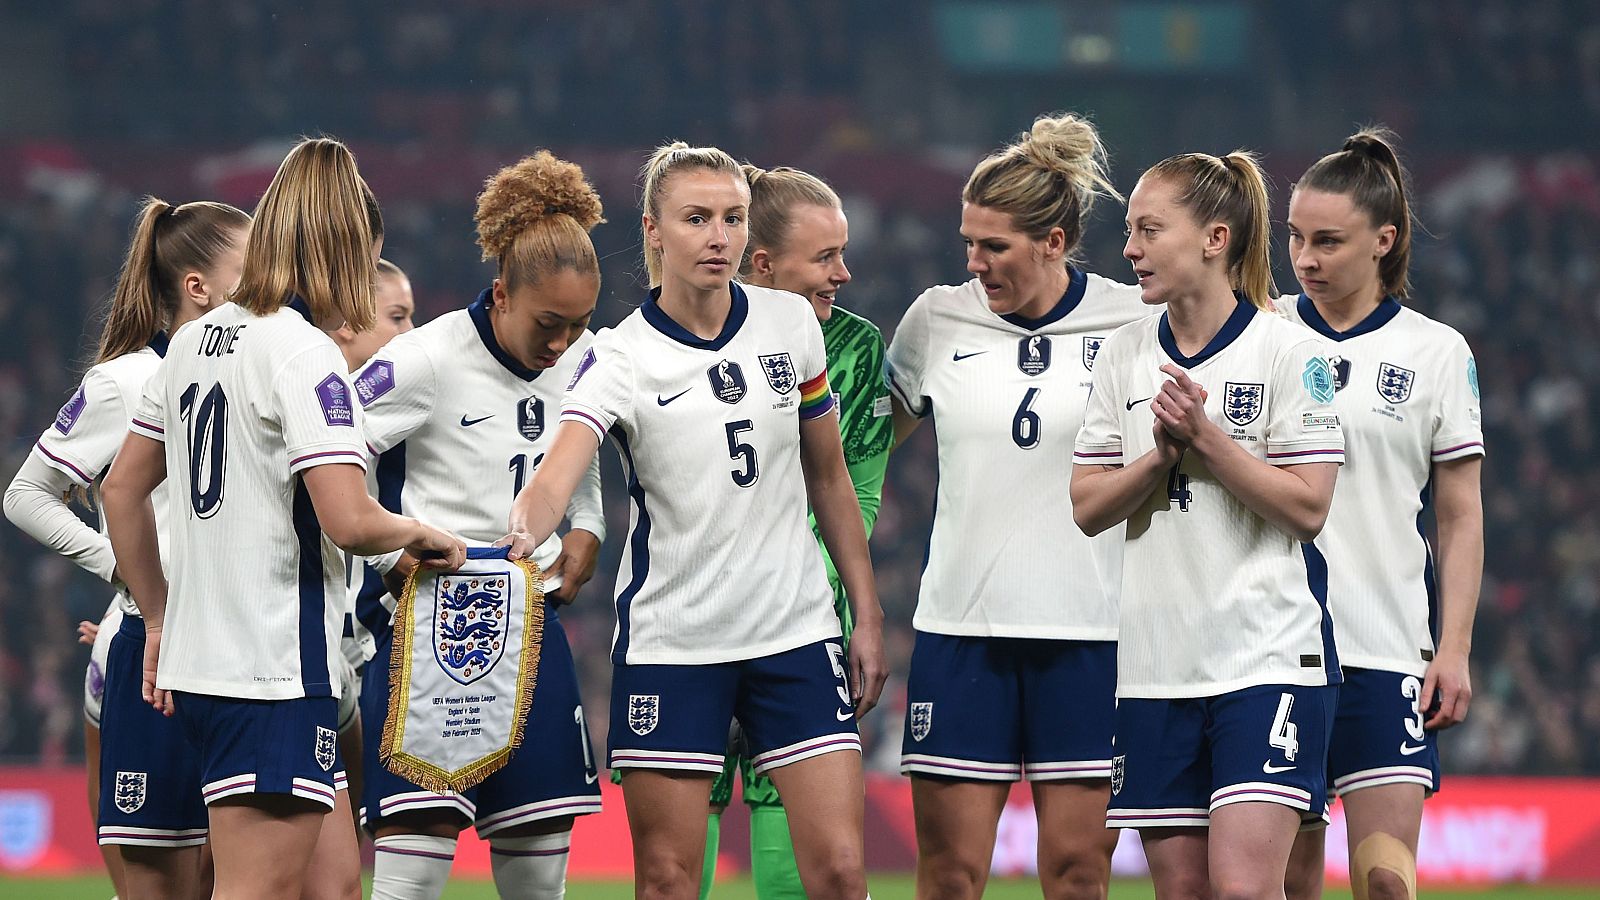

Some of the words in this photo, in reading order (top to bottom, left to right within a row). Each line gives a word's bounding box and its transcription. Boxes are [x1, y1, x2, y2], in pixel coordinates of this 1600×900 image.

[180, 380, 228, 520] 10
[1012, 387, 1041, 450] 6
[724, 418, 760, 489] 5
[1167, 447, 1193, 513] 4
[824, 642, 852, 707] 5
[1269, 692, 1299, 762] 4
[1401, 675, 1425, 741] 3
